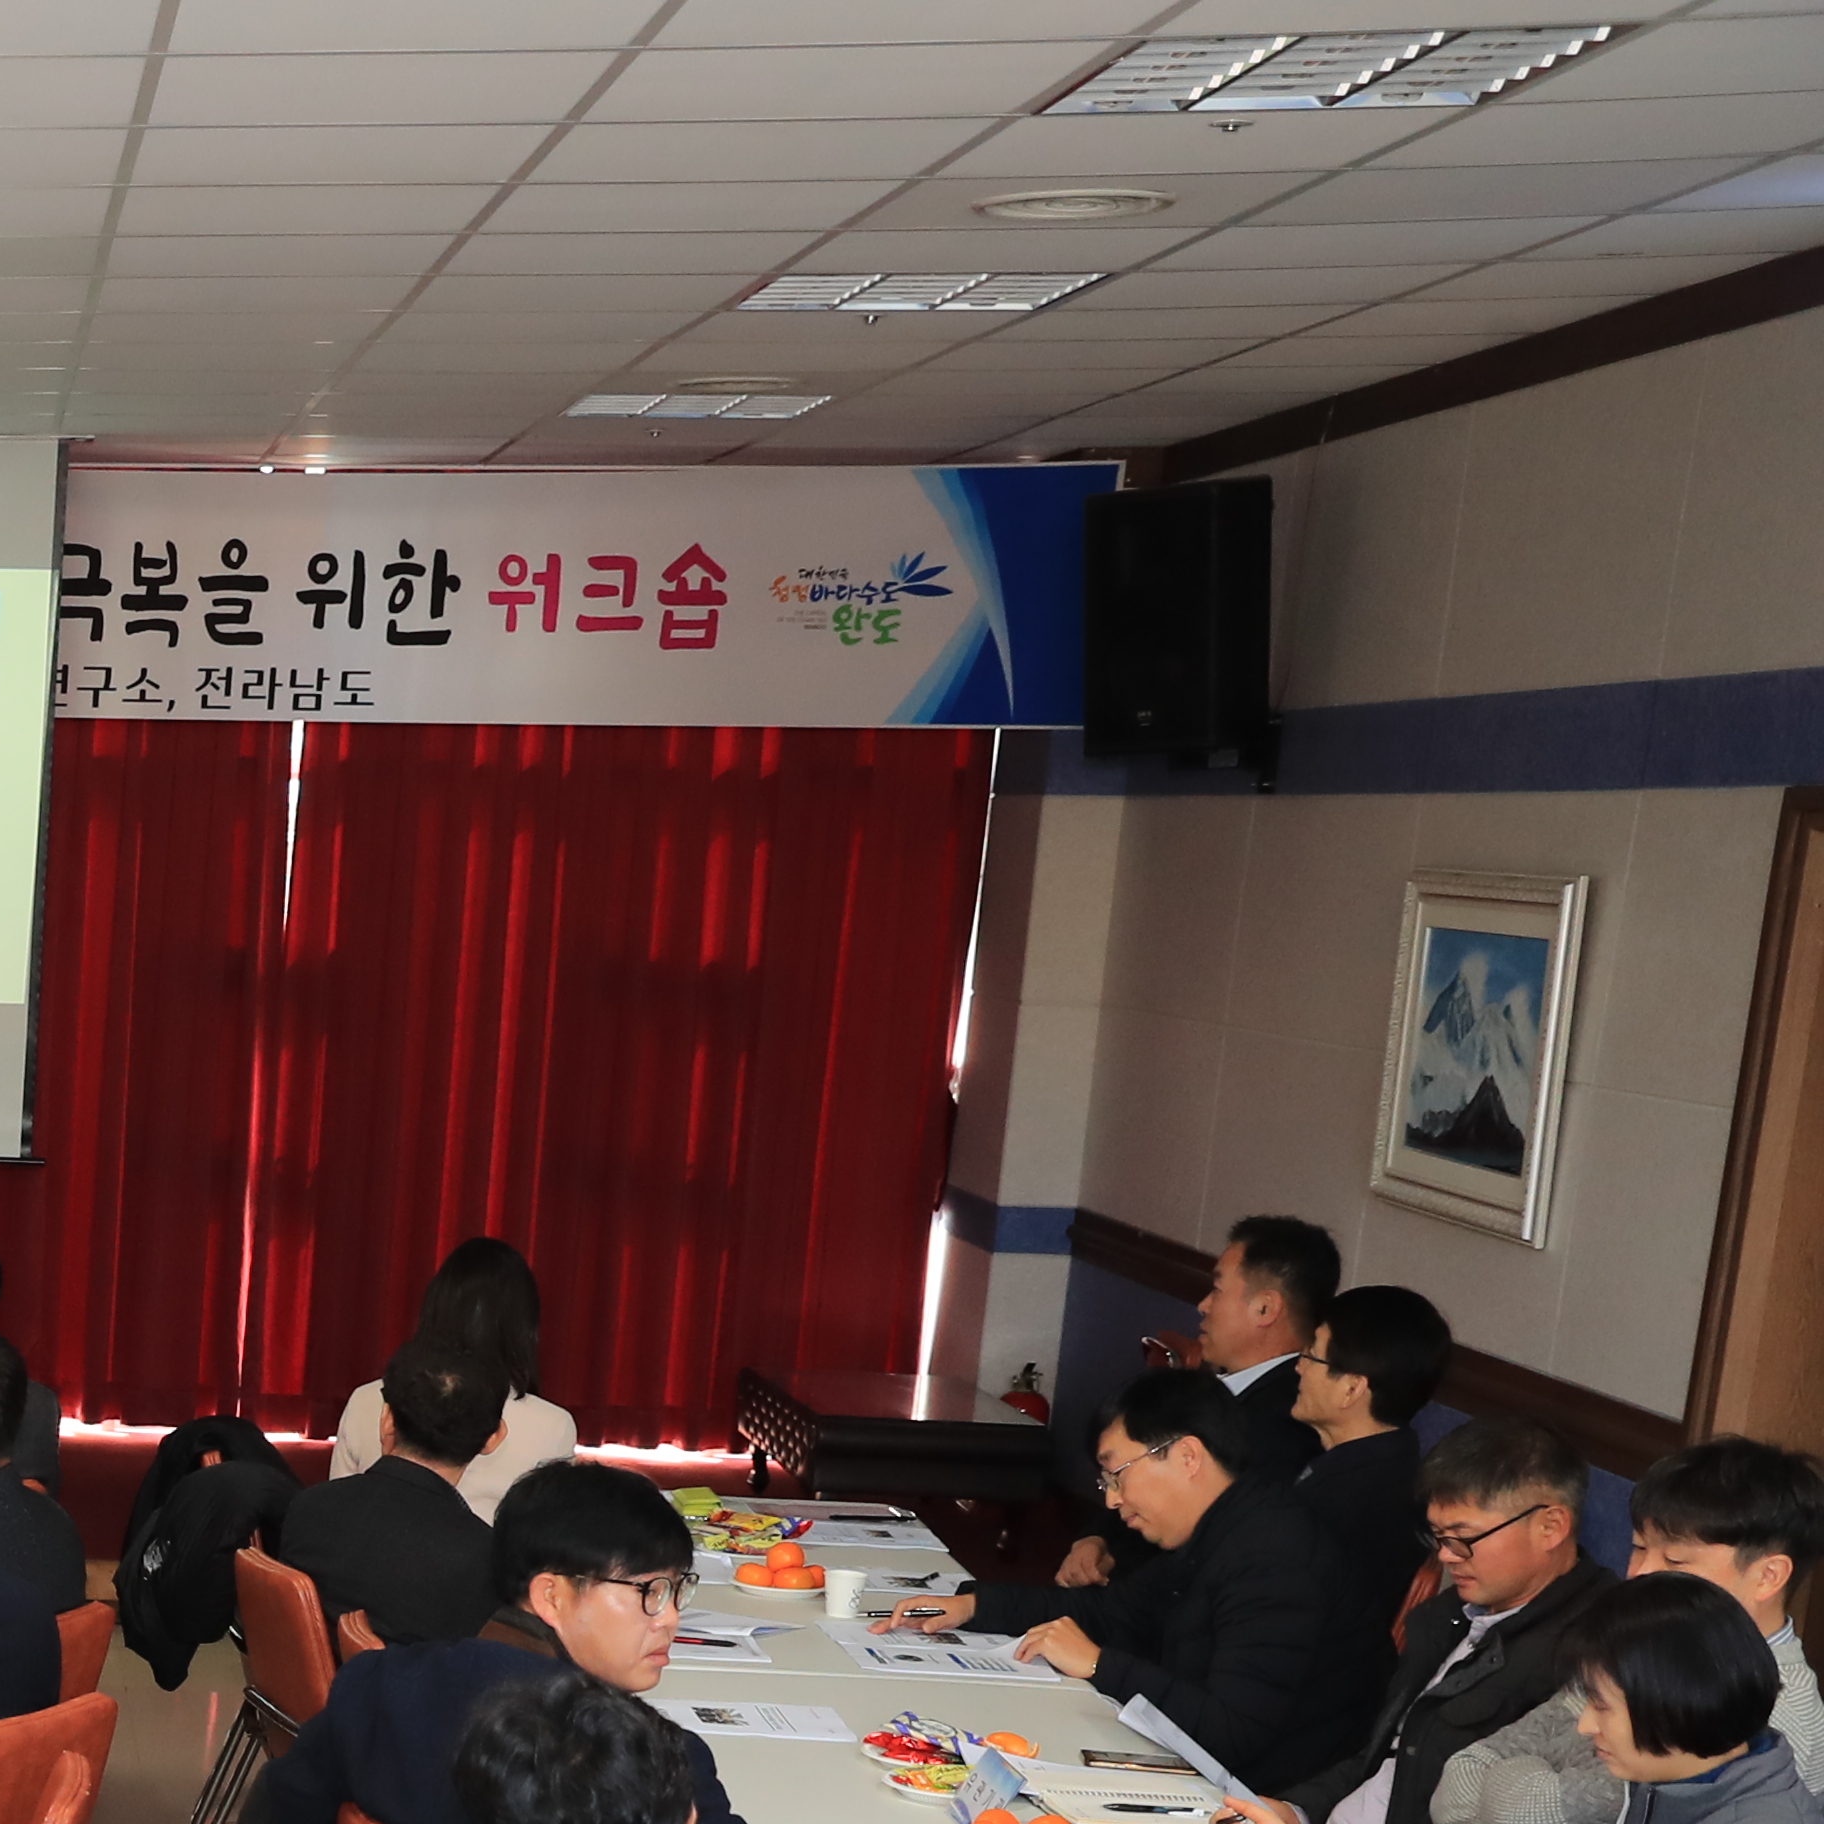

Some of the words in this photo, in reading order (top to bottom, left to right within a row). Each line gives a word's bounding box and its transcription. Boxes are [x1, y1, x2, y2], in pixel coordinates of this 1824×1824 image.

[295, 539, 461, 647] 위한
[487, 542, 728, 650] 워크숍
[832, 604, 901, 645] 완도
[194, 667, 375, 712] 전라남도
